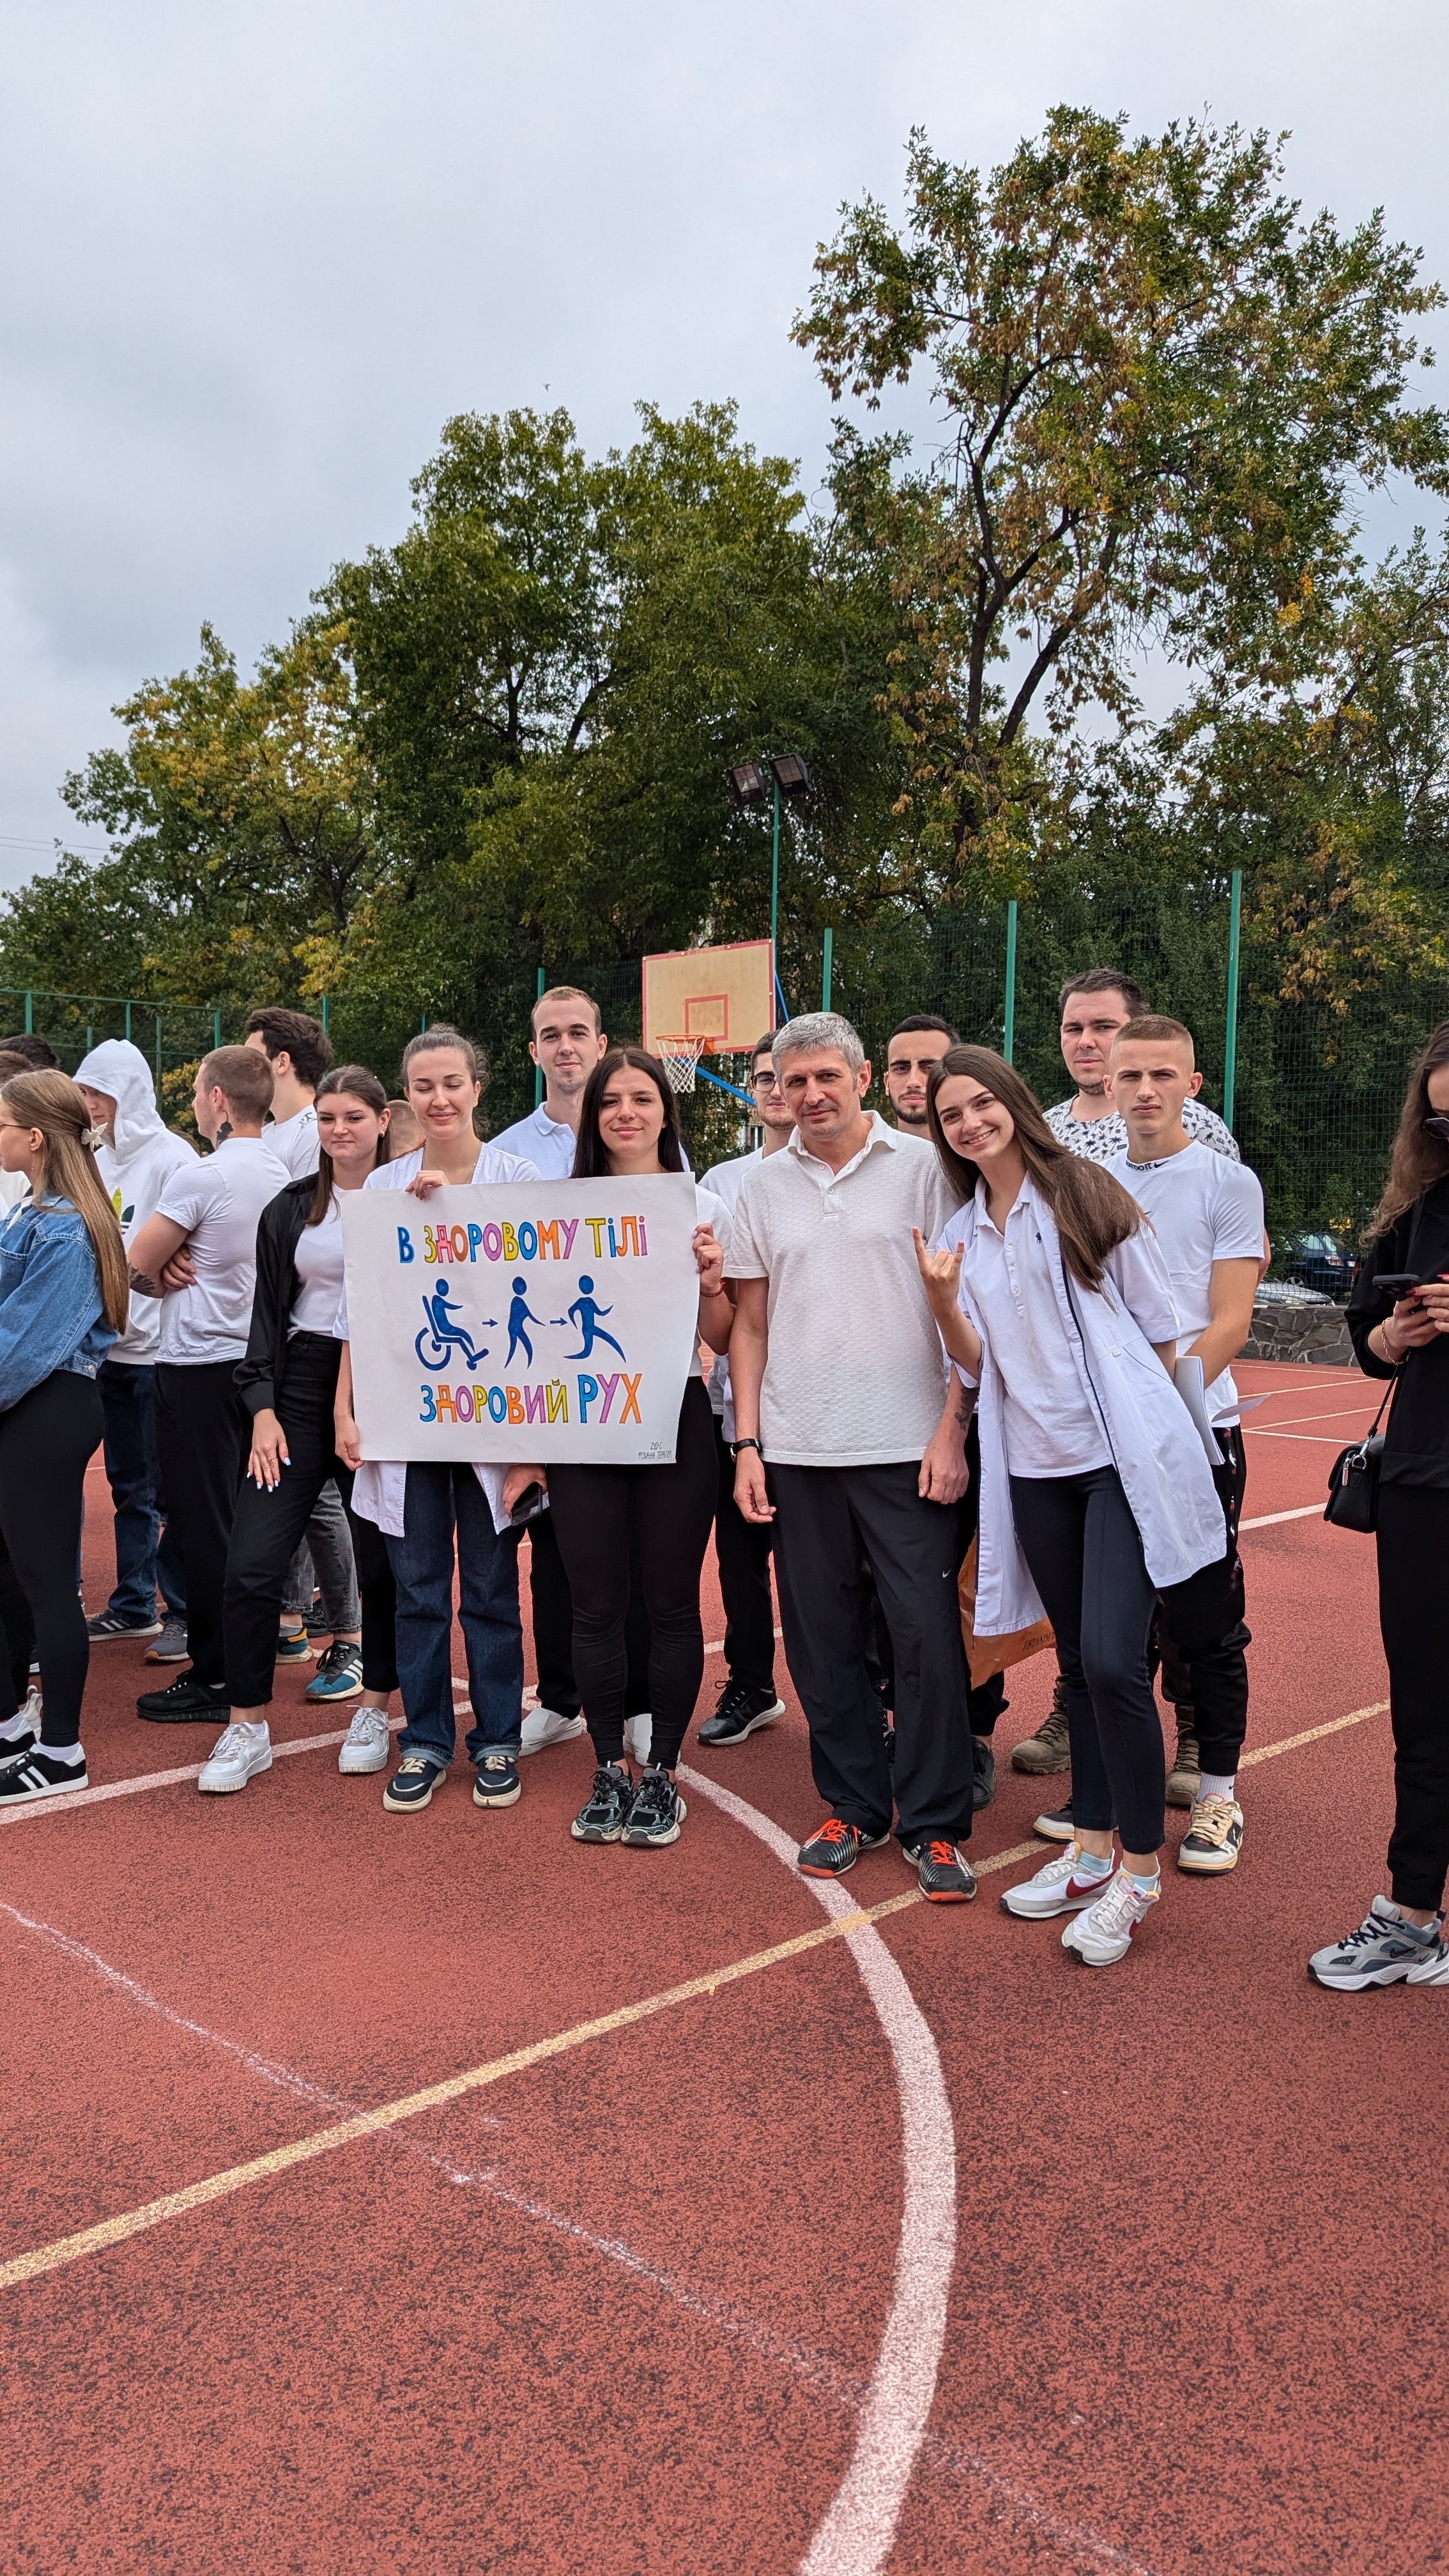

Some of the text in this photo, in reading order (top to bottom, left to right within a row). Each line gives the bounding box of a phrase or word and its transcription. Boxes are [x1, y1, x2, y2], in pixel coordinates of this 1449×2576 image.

[397, 1226, 415, 1264] В
[424, 1218, 580, 1264] ЗДОРОВОМУ
[419, 1373, 643, 1425] ЗДОРОВИЙ РУХ
